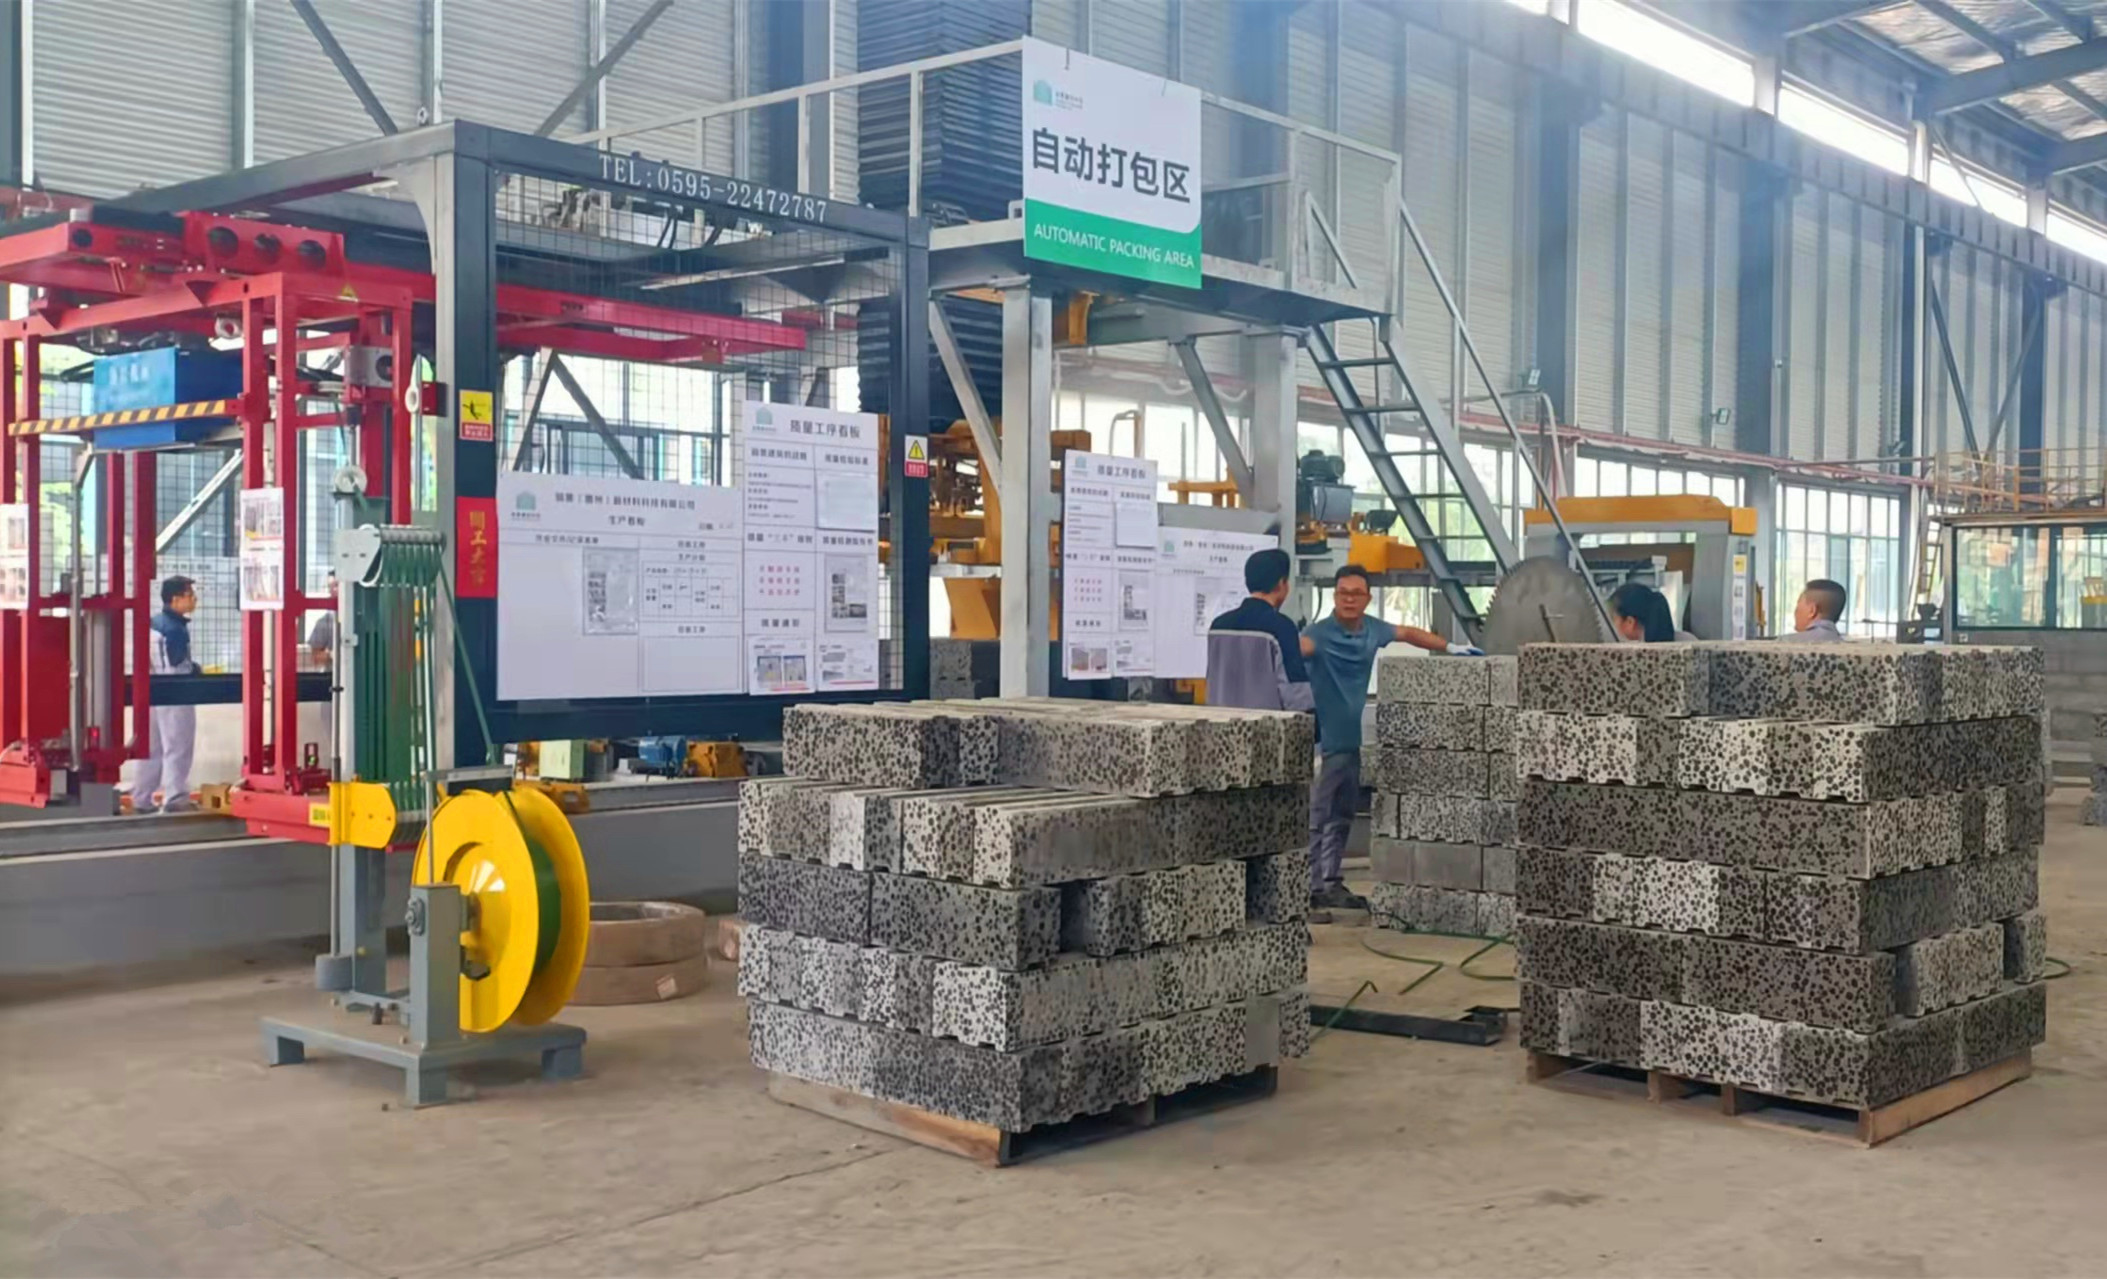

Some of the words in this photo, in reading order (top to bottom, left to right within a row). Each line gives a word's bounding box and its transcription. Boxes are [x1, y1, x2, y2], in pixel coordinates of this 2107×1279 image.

[600, 155, 827, 223] TEL:0595-22472787
[1033, 127, 1190, 203] 自动打包区
[1034, 223, 1106, 252] AUTOMATIC
[1109, 238, 1161, 262] PACKING
[1163, 252, 1195, 268] AREA
